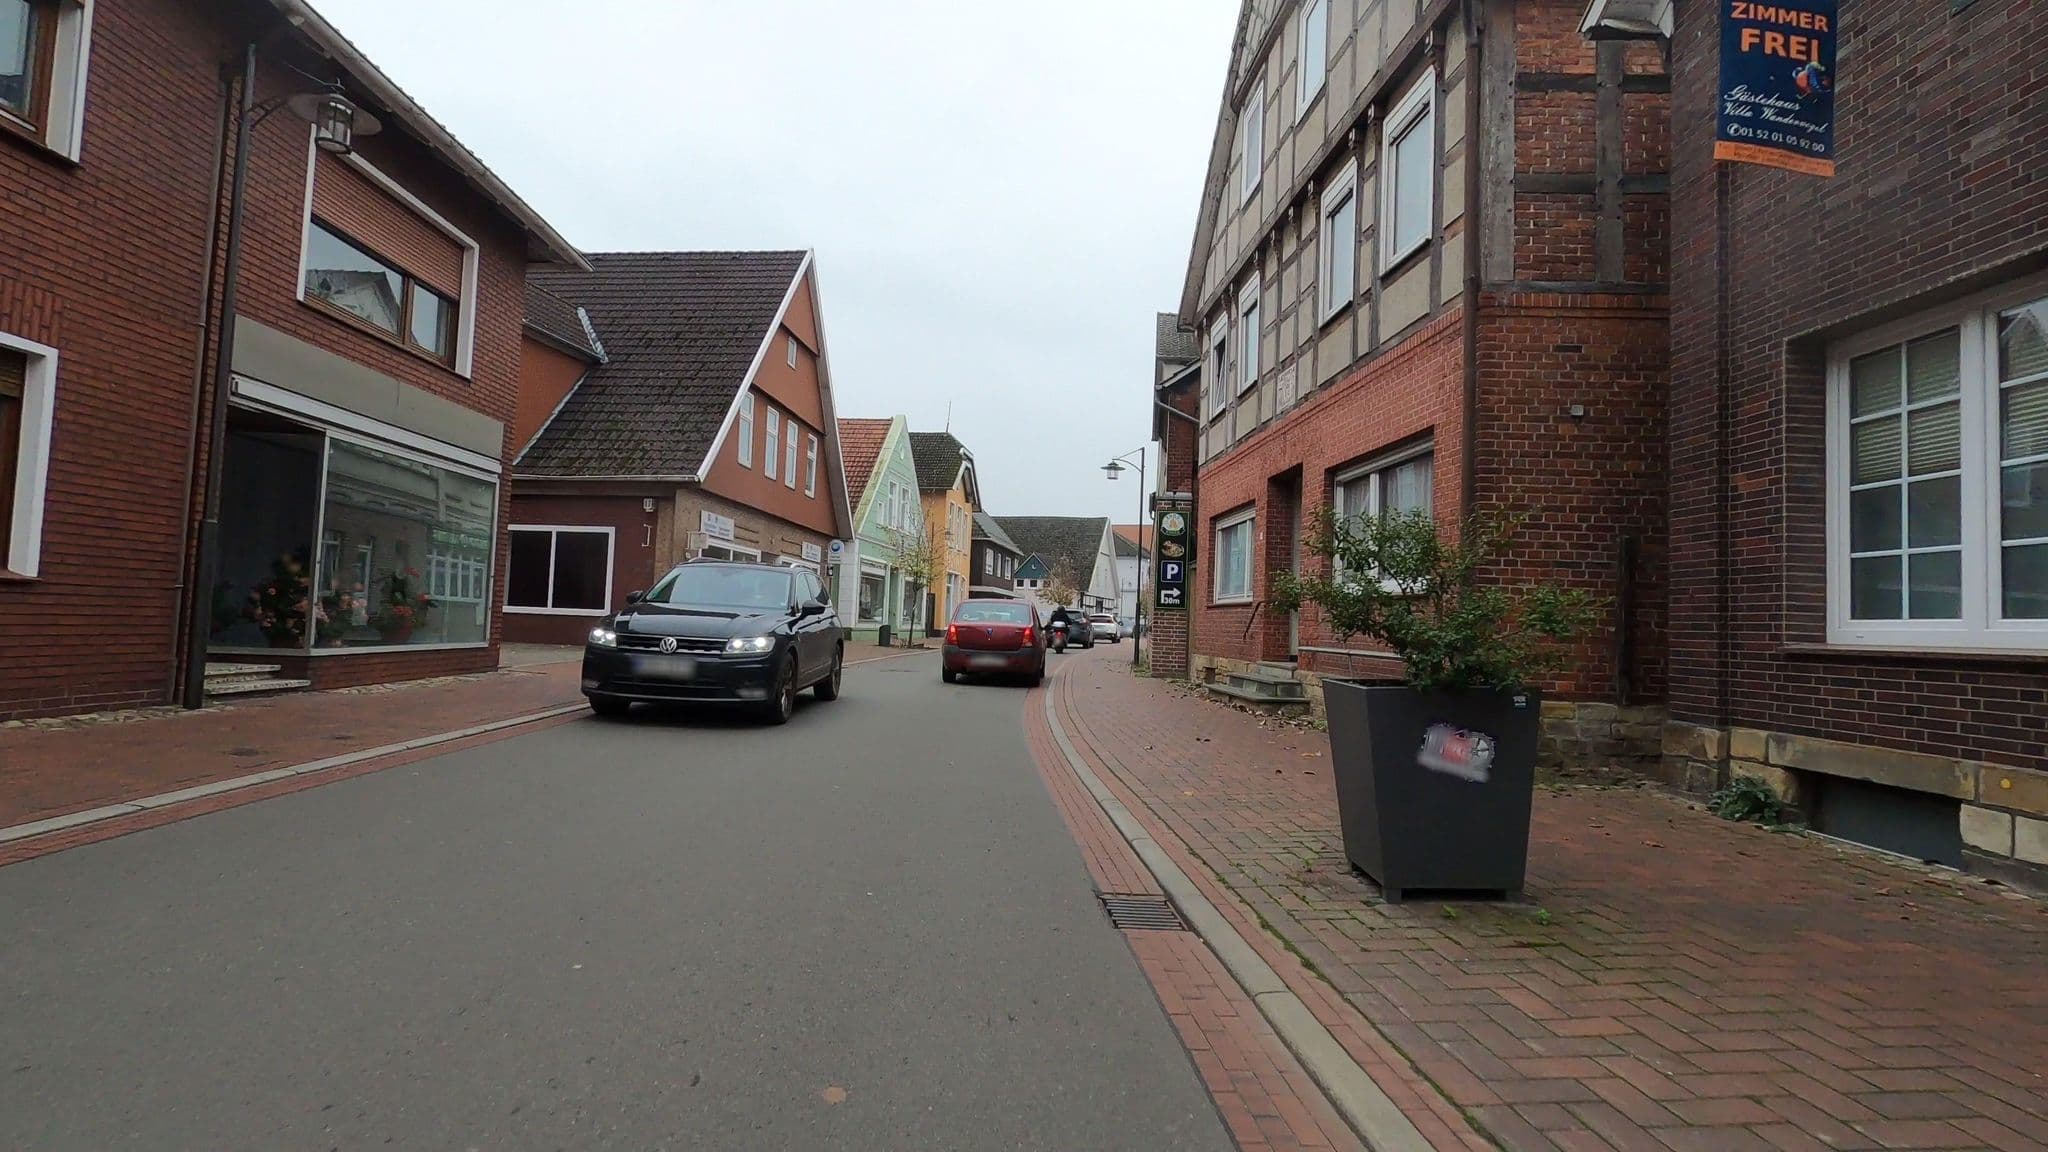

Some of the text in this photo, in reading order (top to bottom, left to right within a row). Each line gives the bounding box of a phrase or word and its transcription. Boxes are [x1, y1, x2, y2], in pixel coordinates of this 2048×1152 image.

[1730, 2, 1828, 32] ZIMMER
[1741, 28, 1819, 63] FREI
[1723, 84, 1800, 111] Gästehaus
[1723, 102, 1753, 117] Villa
[1166, 563, 1179, 580] P
